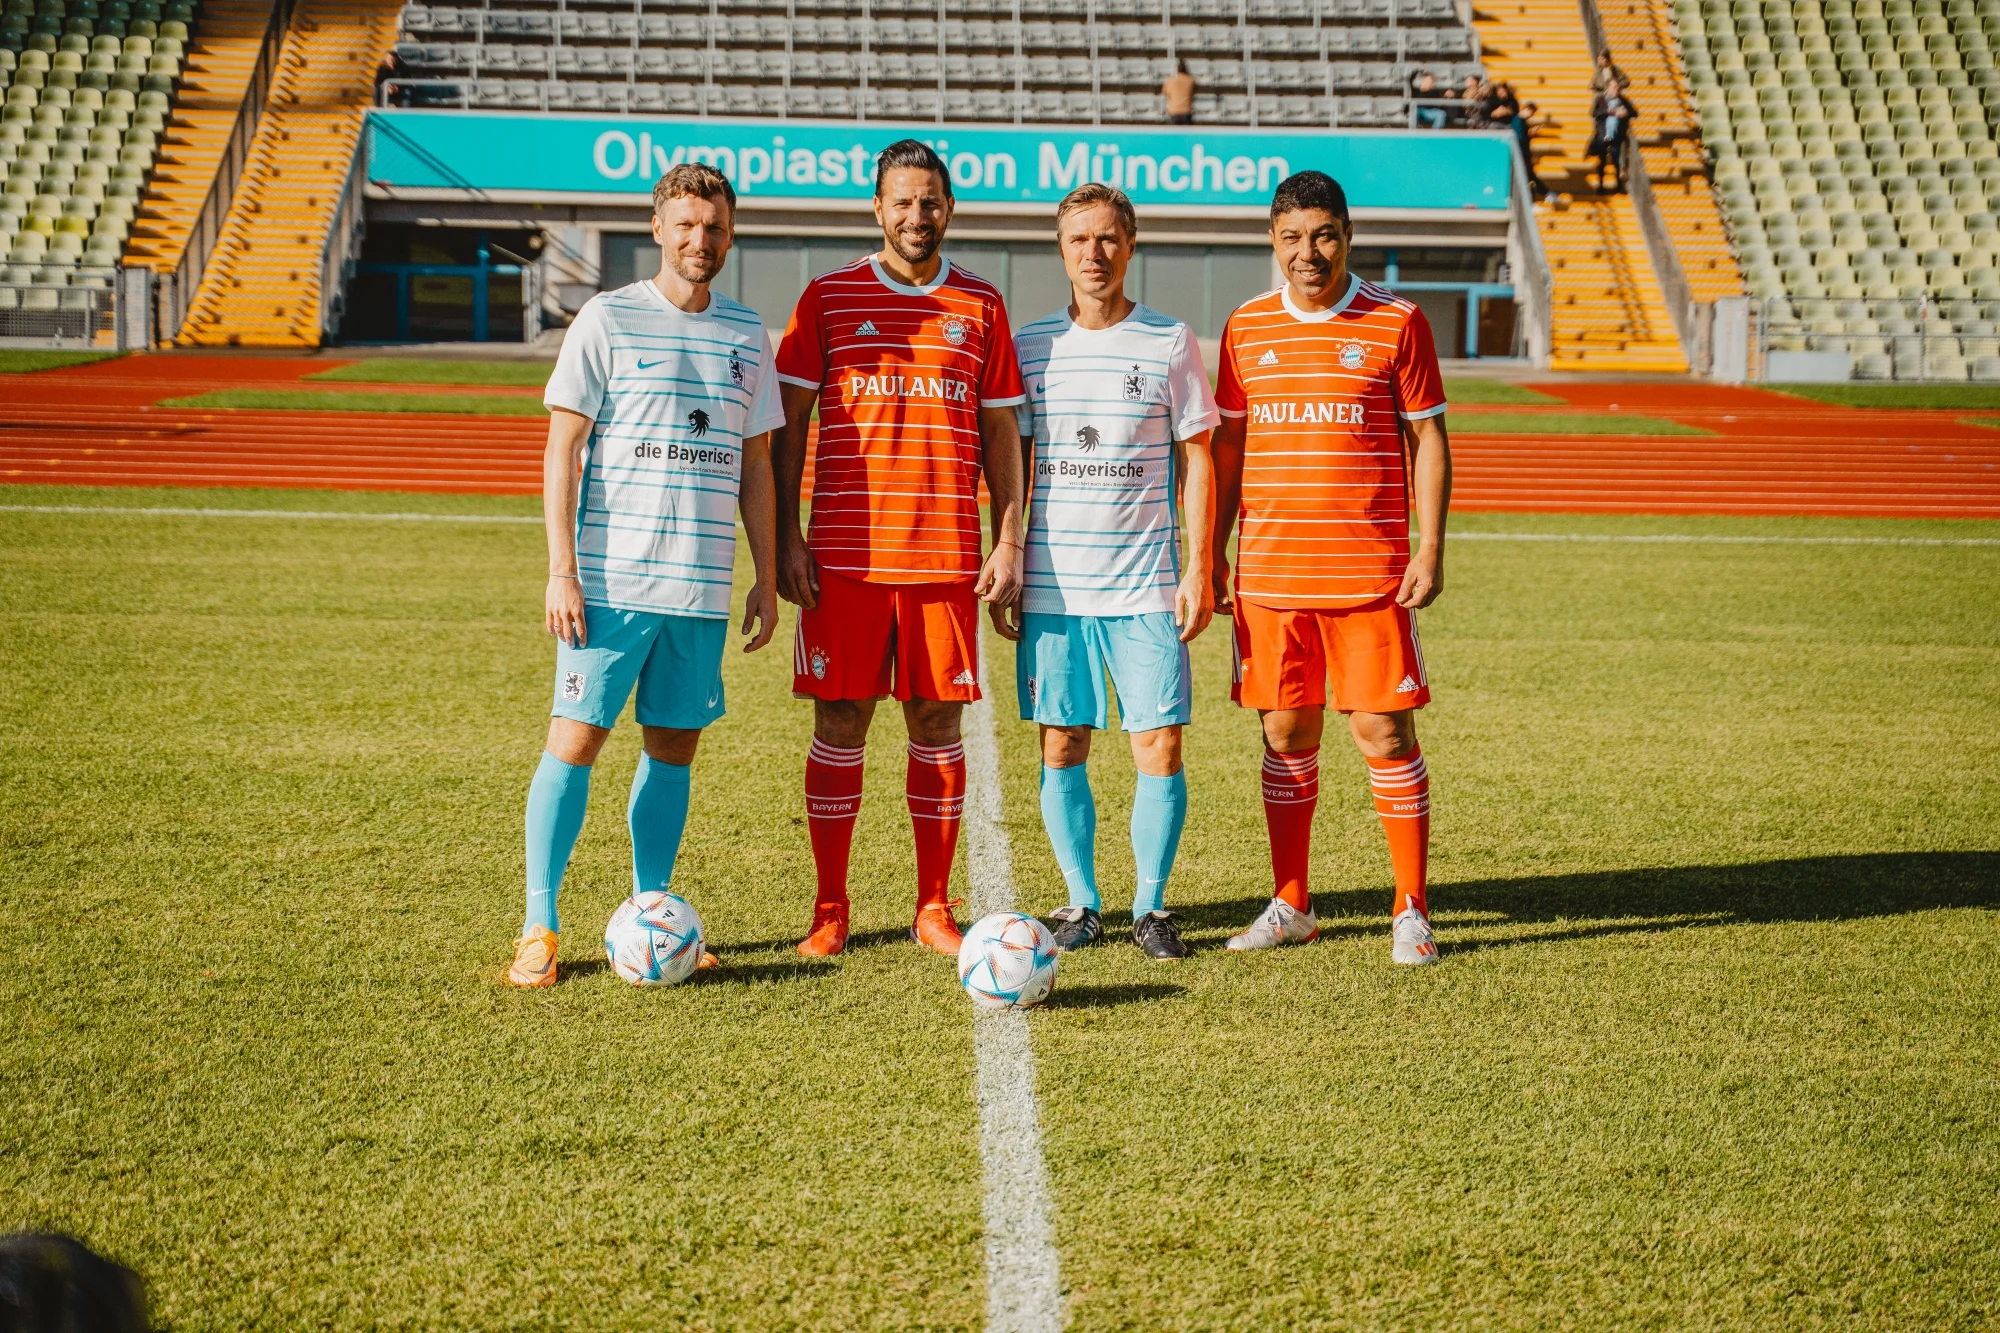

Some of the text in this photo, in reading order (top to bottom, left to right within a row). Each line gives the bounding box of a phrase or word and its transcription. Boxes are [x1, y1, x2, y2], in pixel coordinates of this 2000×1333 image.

[593, 129, 1290, 193] Olympiastion München
[851, 375, 968, 402] PAULANER
[1252, 402, 1365, 425] PAULANER
[634, 443, 662, 459] die
[1039, 460, 1144, 479] die Bayerische
[1262, 787, 1295, 798] AYERN
[812, 802, 852, 812] BAYERN
